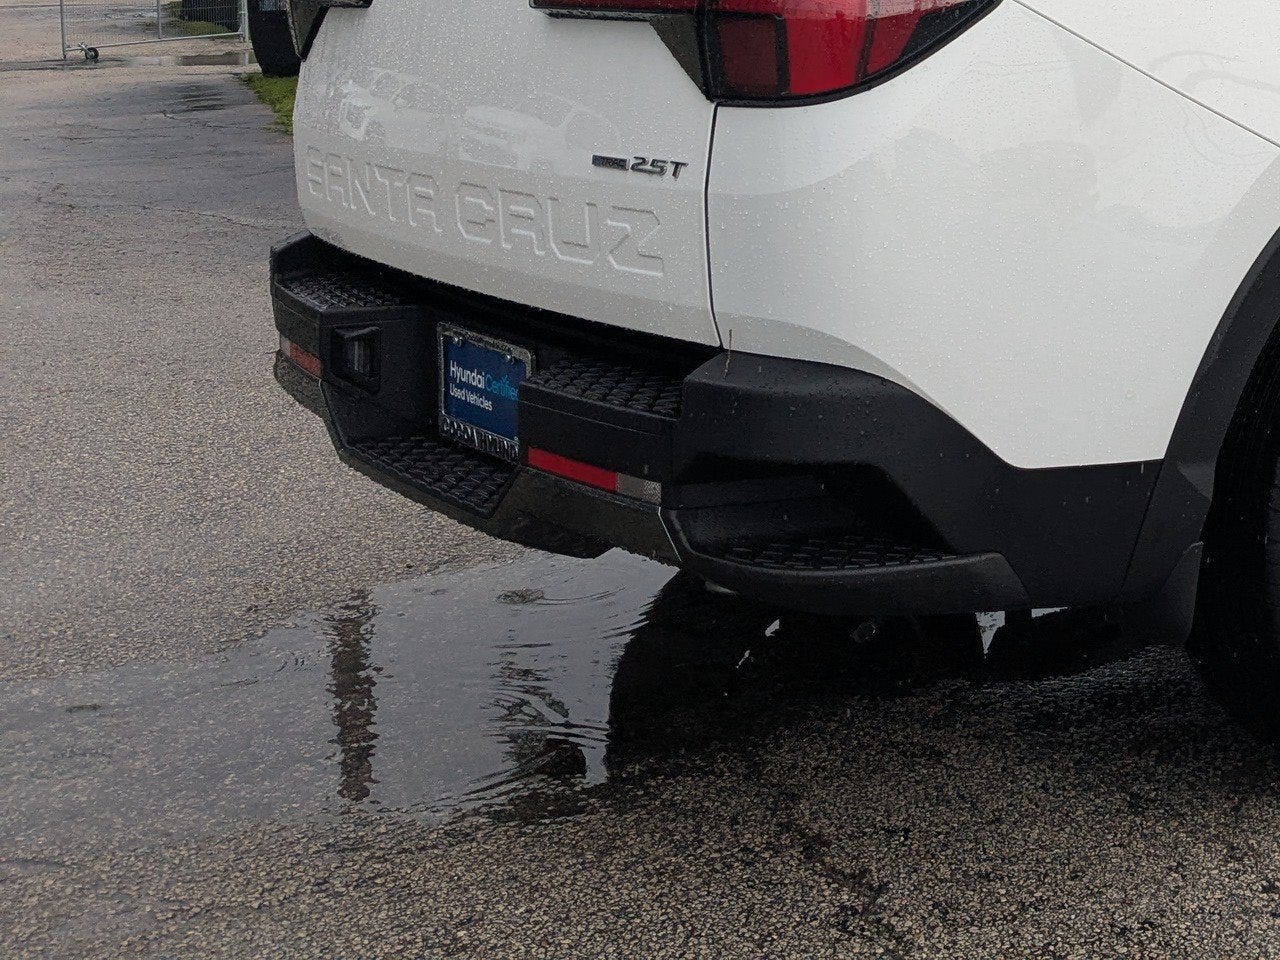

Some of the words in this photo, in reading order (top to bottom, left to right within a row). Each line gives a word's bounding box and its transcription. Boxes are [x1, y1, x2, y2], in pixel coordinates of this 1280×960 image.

[305, 145, 443, 234] SANTA
[454, 181, 665, 277] CRUZ
[449, 360, 485, 390] Hyundai
[449, 383, 465, 400] Used
[465, 389, 493, 411] Vehicles
